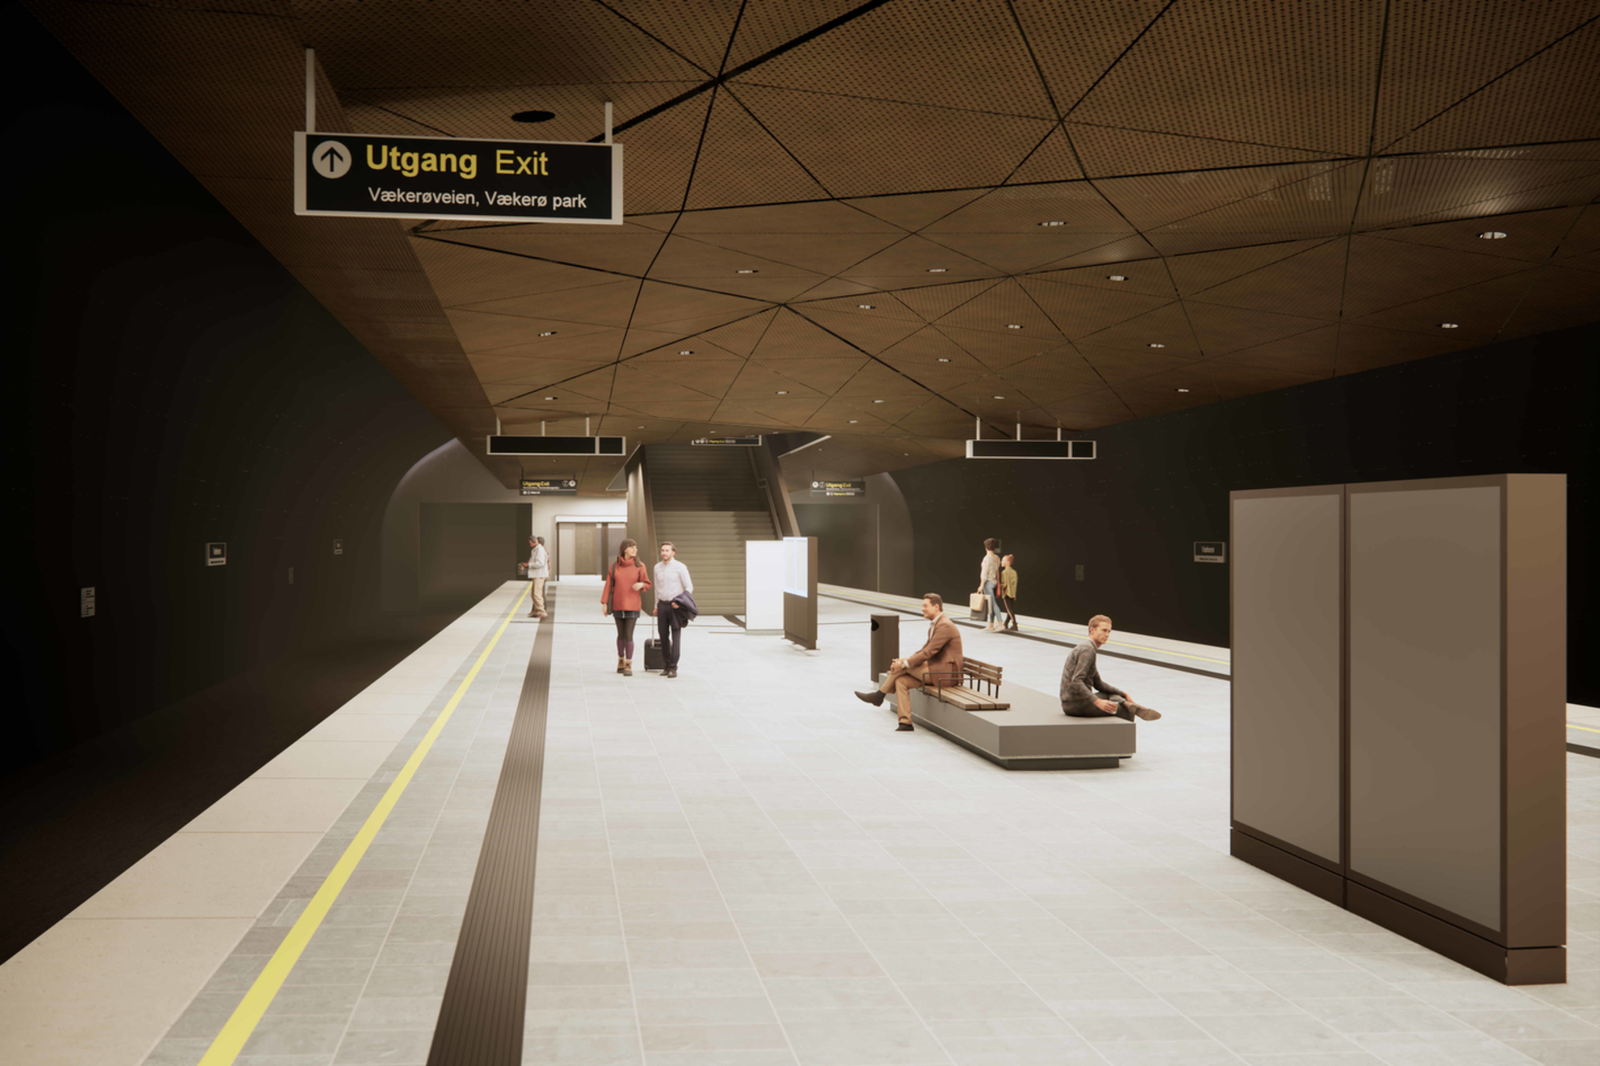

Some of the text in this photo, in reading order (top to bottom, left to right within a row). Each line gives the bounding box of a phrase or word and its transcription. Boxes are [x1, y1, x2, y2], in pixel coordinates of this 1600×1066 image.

[366, 144, 549, 180] Utgang Exit
[368, 187, 587, 211] Vækerøveien, Vækerø park
